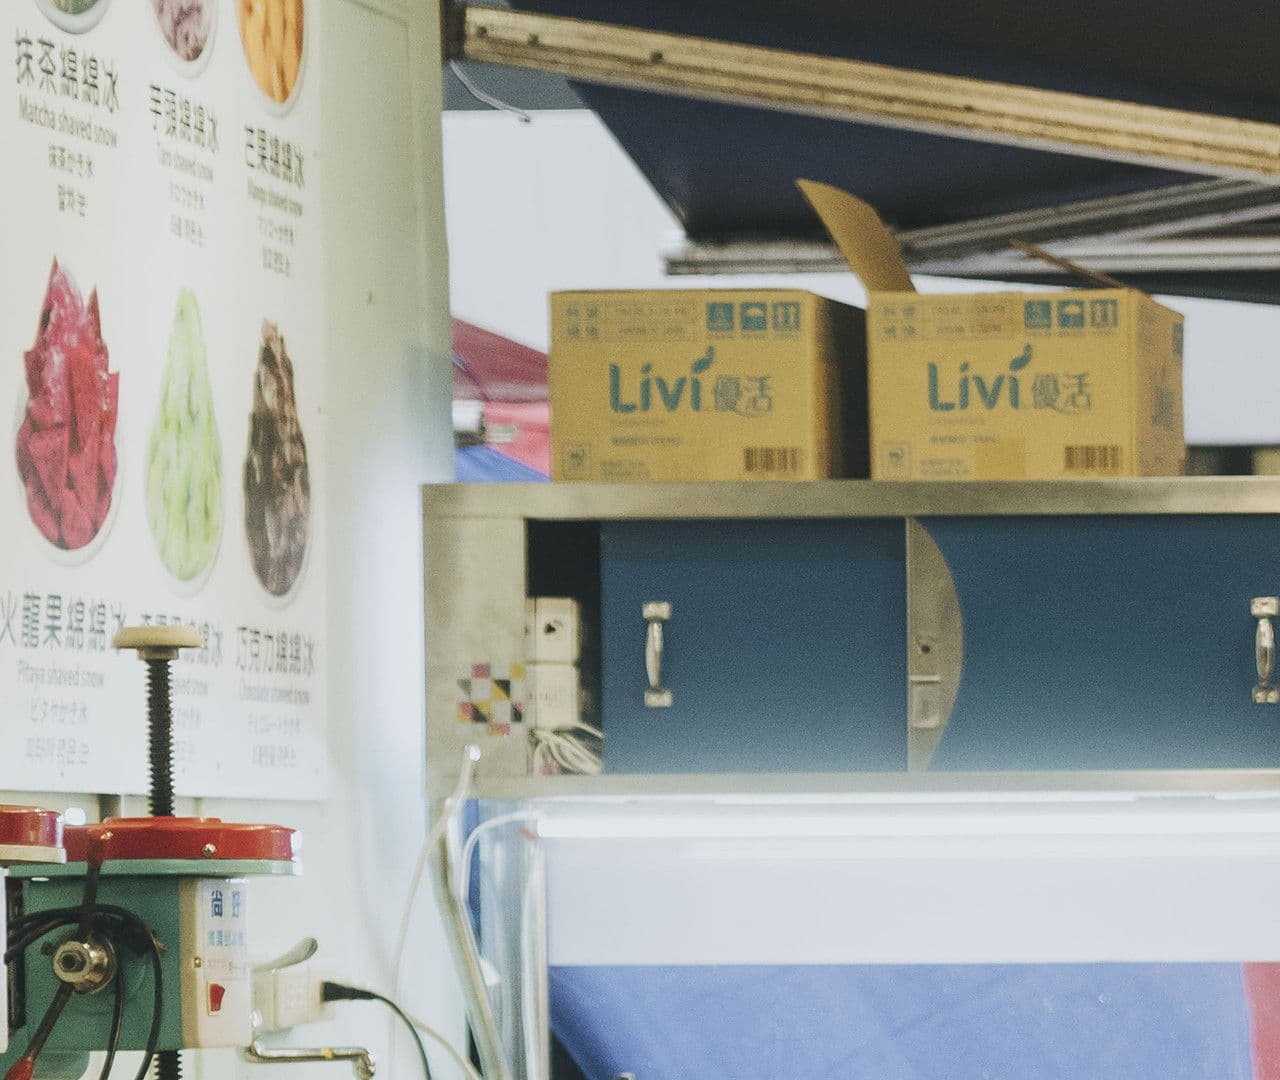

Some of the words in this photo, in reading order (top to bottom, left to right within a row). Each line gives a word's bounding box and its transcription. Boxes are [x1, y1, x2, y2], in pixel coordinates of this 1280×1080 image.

[19, 94, 56, 130] Matcha
[609, 346, 715, 413] Livi
[713, 374, 774, 415] 優活
[927, 343, 1033, 412] Livi
[1031, 372, 1093, 415] 優活
